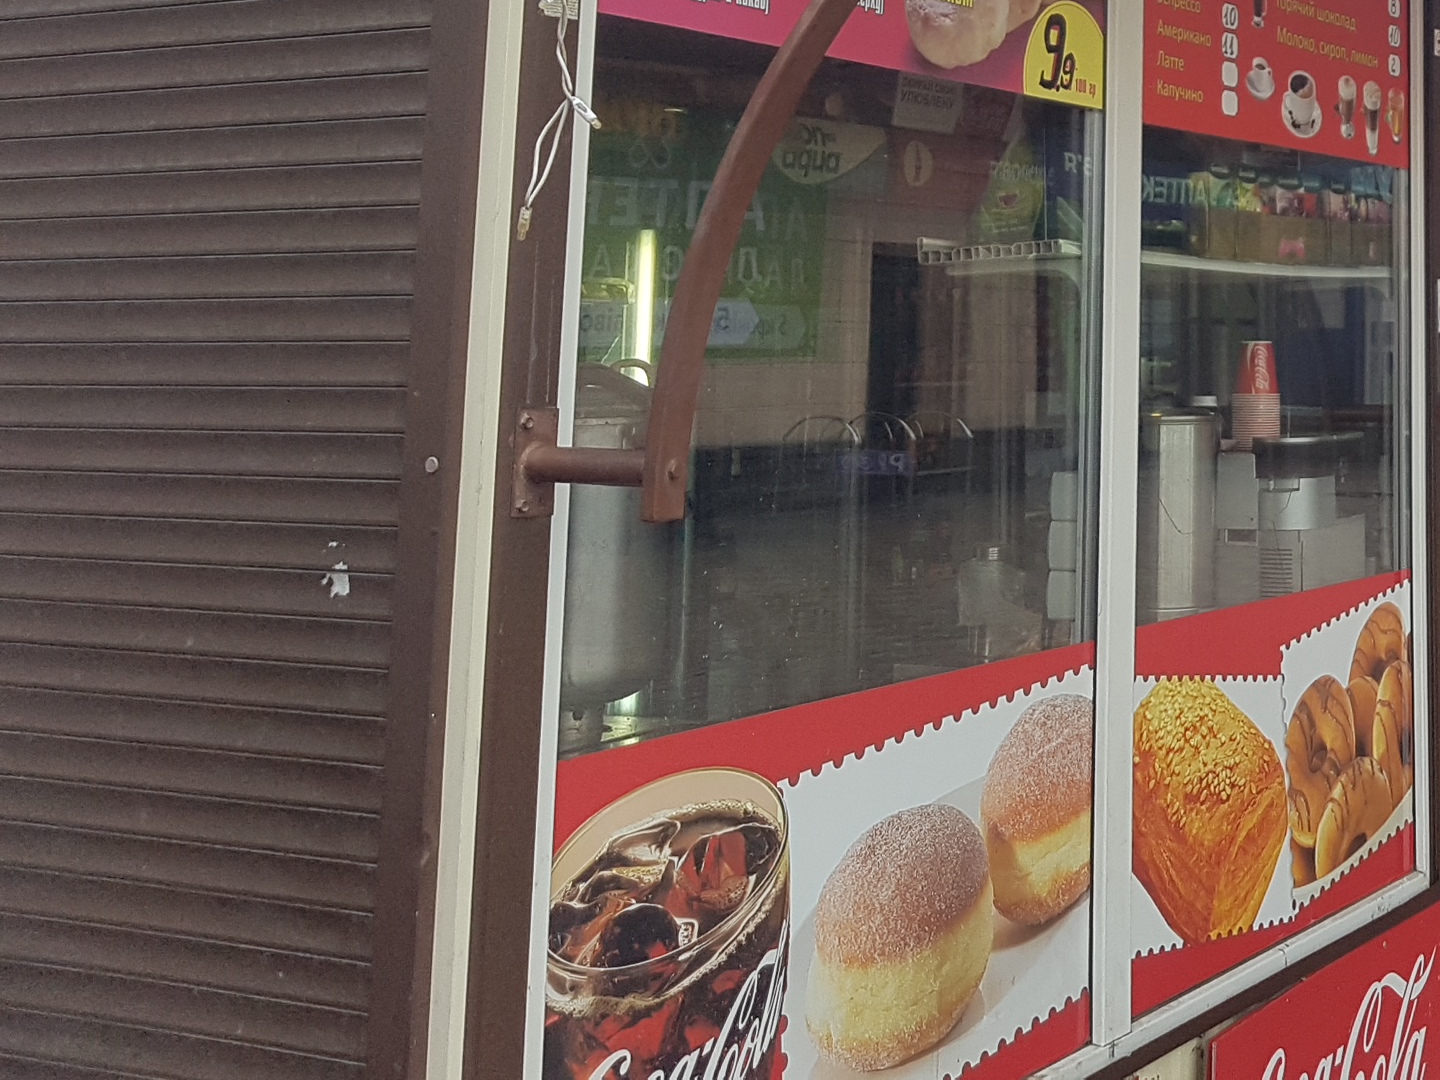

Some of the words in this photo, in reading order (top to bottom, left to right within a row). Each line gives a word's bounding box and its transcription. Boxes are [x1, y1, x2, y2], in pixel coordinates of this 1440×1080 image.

[1223, 7, 1238, 27] 10
[1317, 3, 1357, 32] шоколад
[1157, 19, 1212, 47] Американо
[1277, 25, 1318, 54] Молоко,
[1319, 38, 1349, 64] сироп,
[1350, 50, 1379, 69] лимон
[1157, 50, 1185, 71] Латте
[1157, 79, 1204, 103] Капучино
